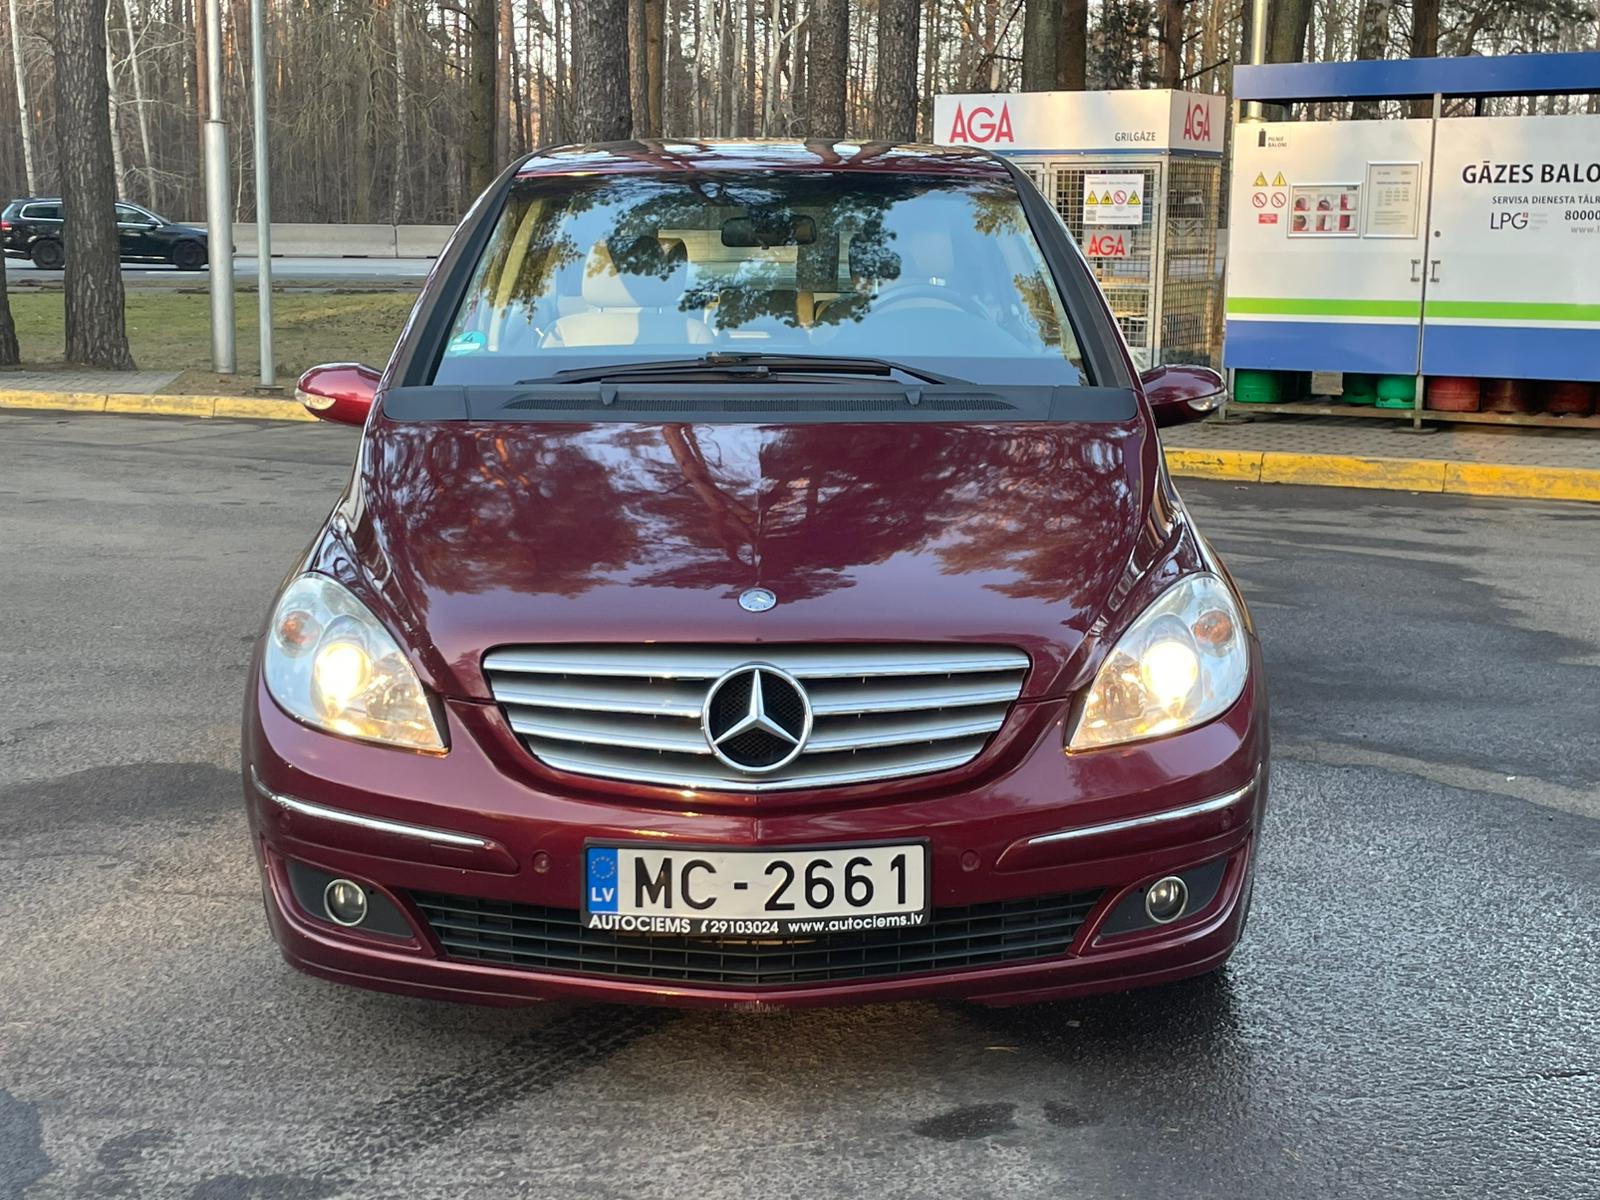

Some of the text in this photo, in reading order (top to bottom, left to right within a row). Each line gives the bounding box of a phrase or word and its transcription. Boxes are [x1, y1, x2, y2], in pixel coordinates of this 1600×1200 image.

[949, 100, 1014, 143] AGA
[1183, 99, 1211, 142] AGA
[1462, 160, 1534, 184] GĀZES
[1492, 195, 1529, 205] SERVISA
[1531, 194, 1575, 204] DIENESTA
[1490, 212, 1528, 230] LPG
[1087, 232, 1126, 256] AGA
[591, 887, 615, 903] LV
[588, 913, 924, 935] AUTOCIEMS 29103024 www.autociems.lv
